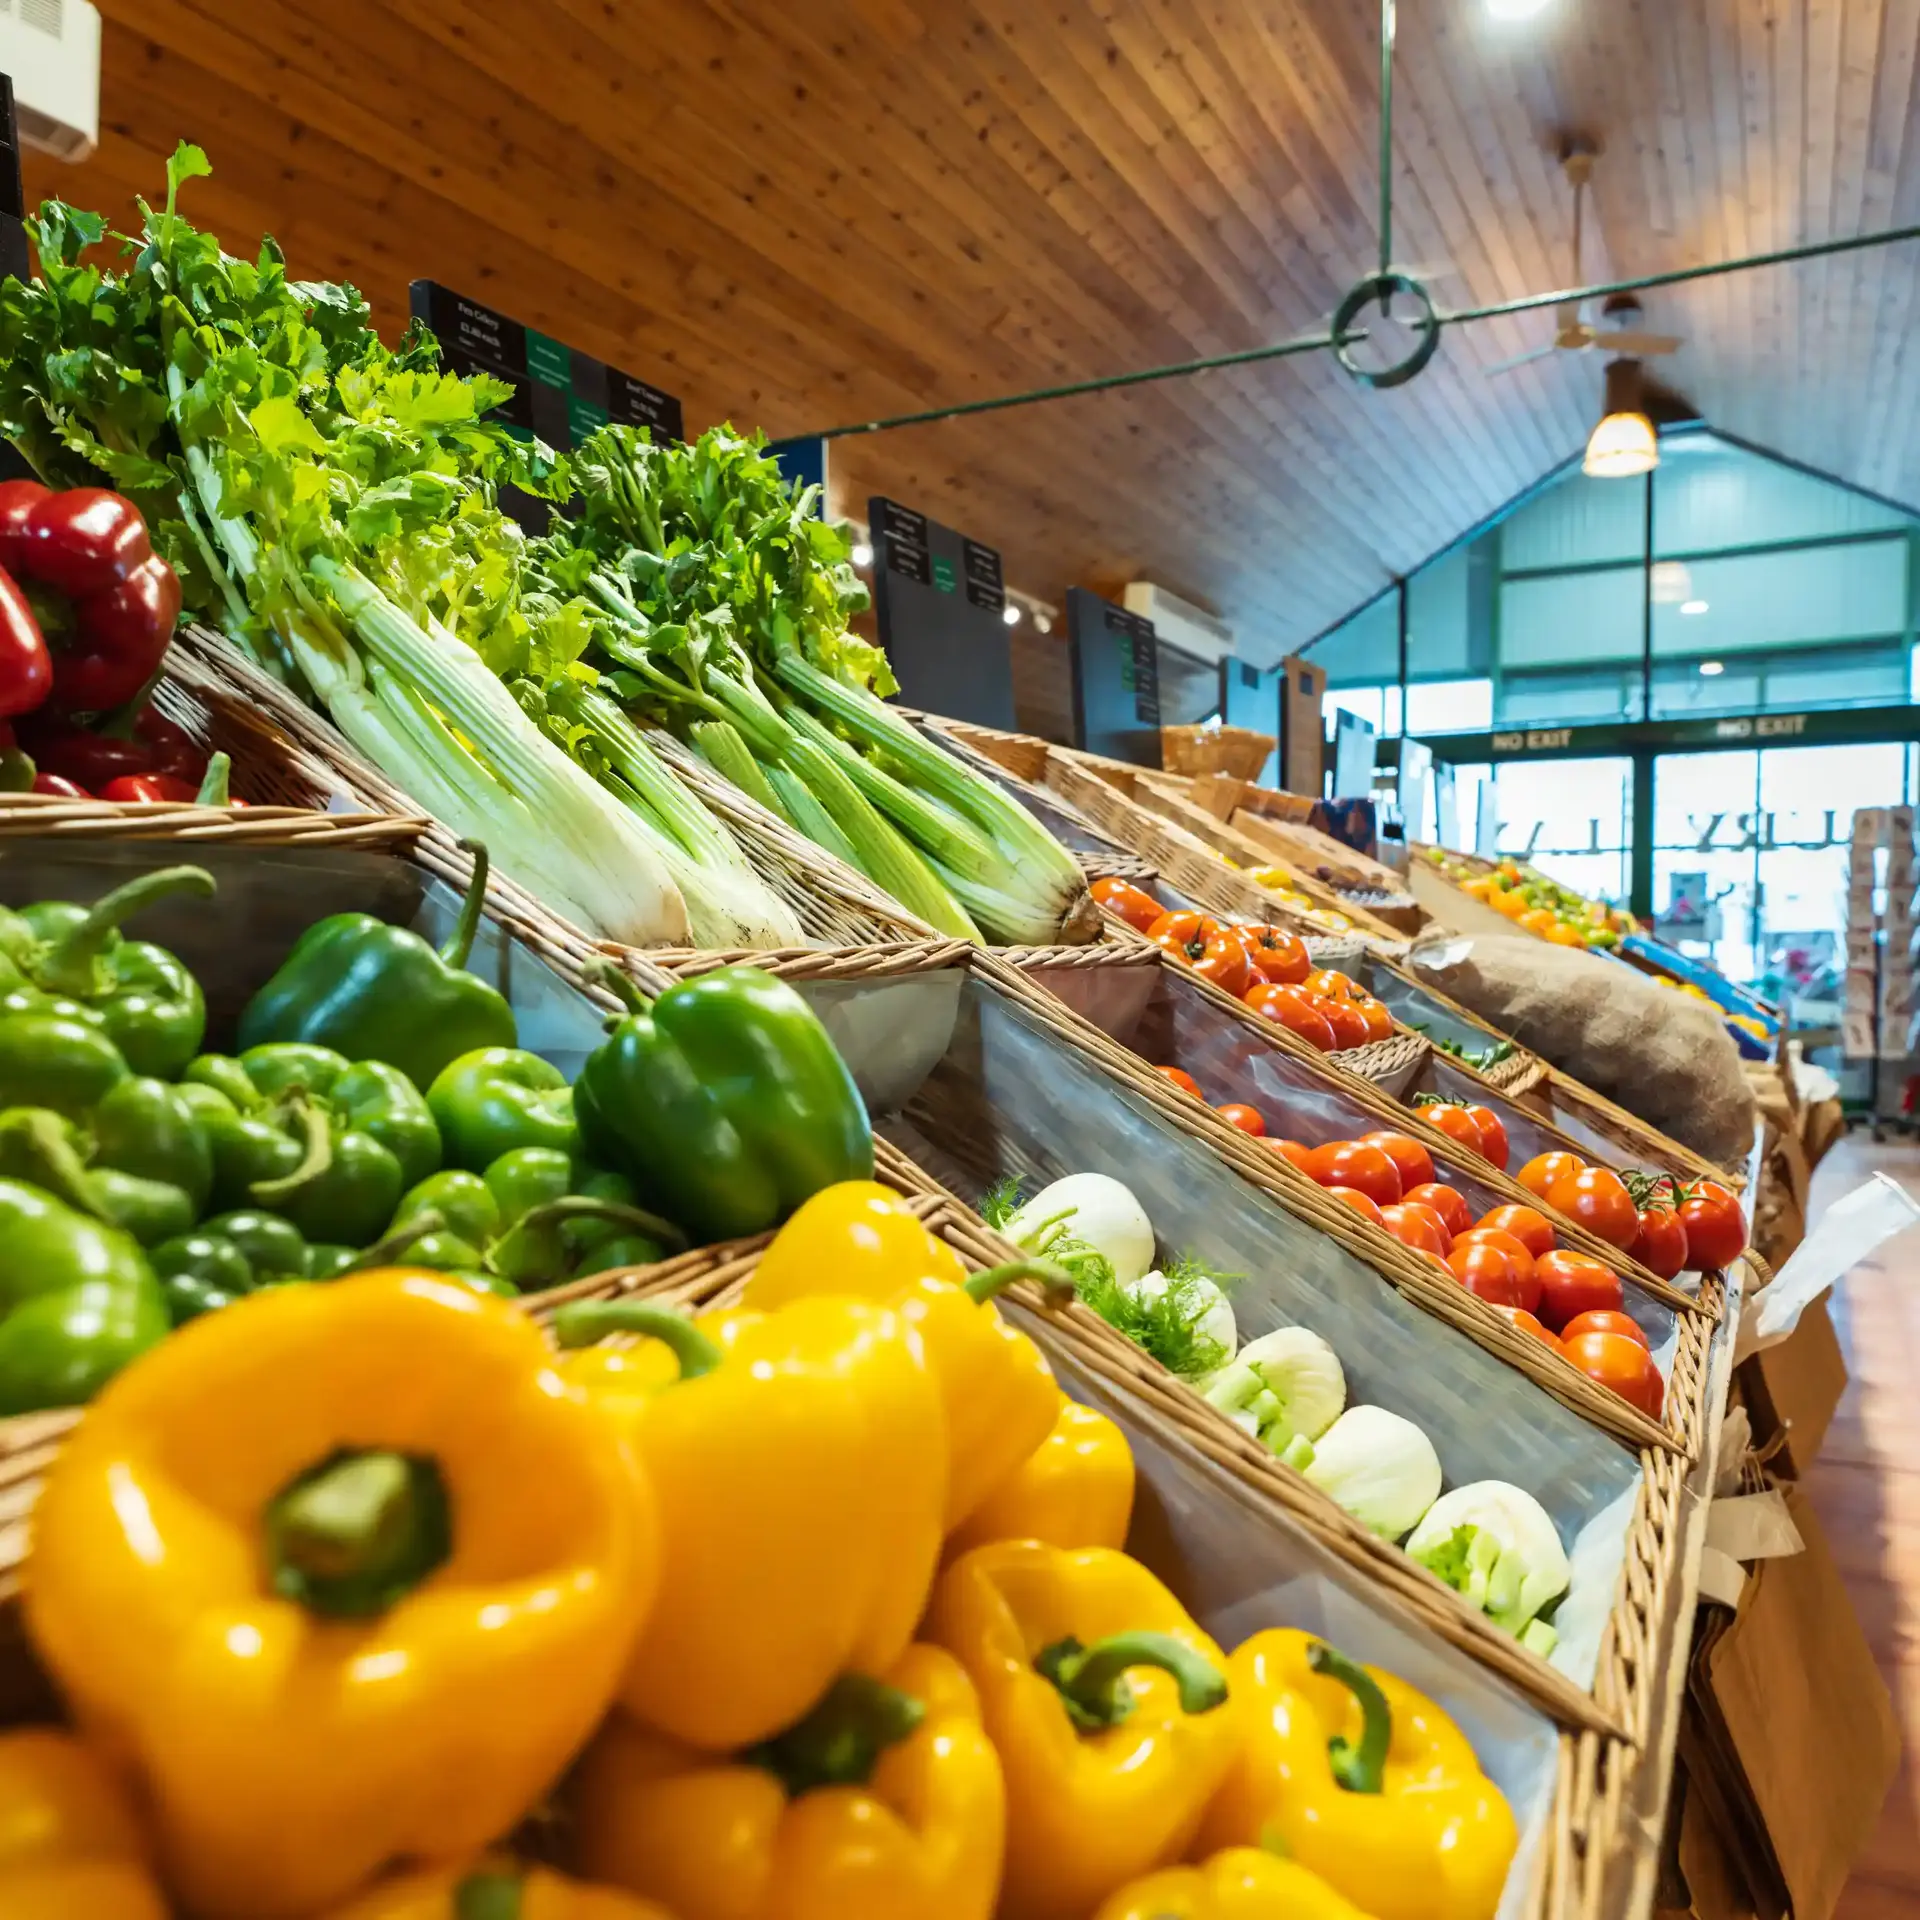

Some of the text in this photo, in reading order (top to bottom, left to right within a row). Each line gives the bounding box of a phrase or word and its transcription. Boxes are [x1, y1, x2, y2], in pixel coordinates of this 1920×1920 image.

[1717, 714, 1808, 738] NO EXIT
[1492, 729, 1572, 751] NO EXIT
